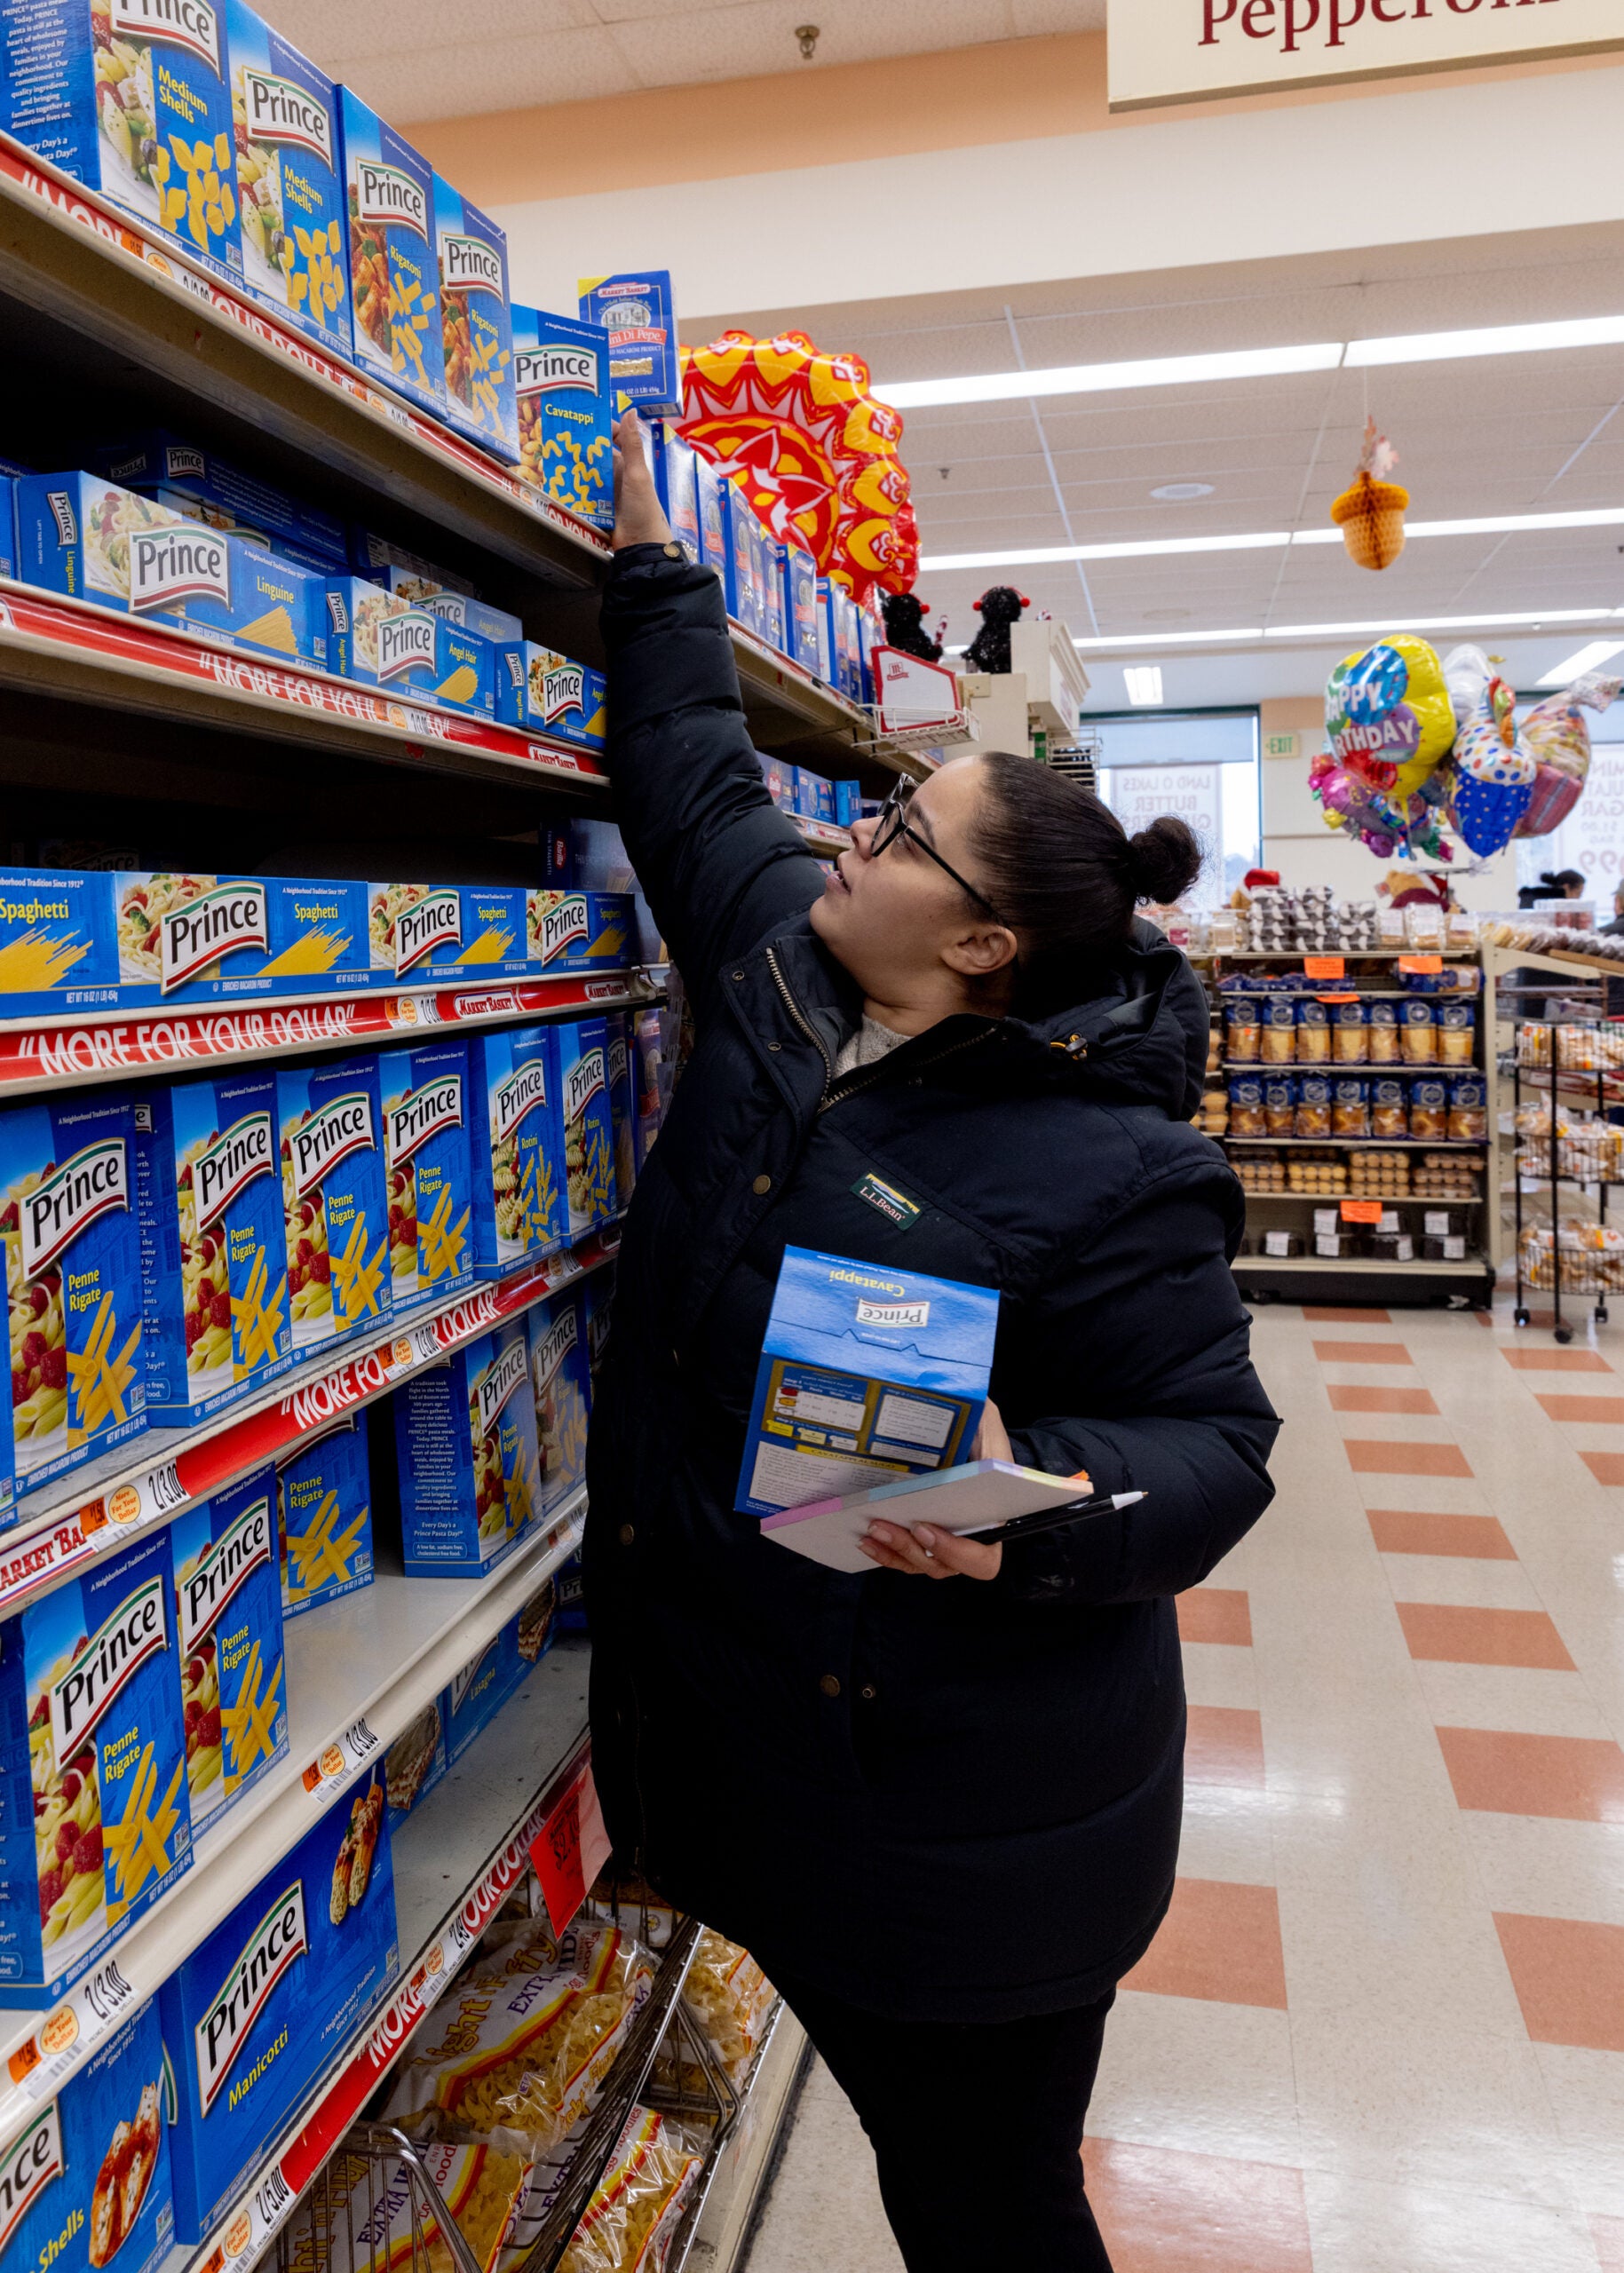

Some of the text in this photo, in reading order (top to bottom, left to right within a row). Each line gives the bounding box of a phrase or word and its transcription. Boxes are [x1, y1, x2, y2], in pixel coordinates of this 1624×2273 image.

[158, 65, 209, 116] Medium
[159, 85, 194, 124] Shells
[252, 81, 325, 142] Prince
[284, 164, 323, 207] Medium
[285, 184, 313, 215] Shells
[364, 169, 422, 219] Prince
[390, 245, 422, 280] Rigatoni
[448, 242, 499, 283] Prince
[471, 308, 499, 339] Rigatoni
[623, 331, 635, 343] Di
[638, 329, 663, 343] Pepe.
[516, 352, 590, 384] Prince
[545, 404, 594, 424] Cavatappi
[170, 449, 202, 469] Prince
[54, 495, 73, 540] Prince
[65, 550, 75, 594] Linguine
[139, 533, 221, 586] Prince
[257, 575, 294, 604] Linguine
[331, 595, 345, 630] Prince
[479, 620, 495, 634] Angel
[494, 624, 506, 637] Hair
[383, 620, 431, 661] Prince
[448, 643, 477, 664] Angel Hair
[510, 655, 521, 684] Prince
[284, 673, 324, 711] FOR
[546, 672, 580, 708] Prince
[1327, 681, 1382, 721] APPY
[1269, 736, 1293, 755] EXIT
[1334, 719, 1414, 757] RTHDAY
[0, 898, 69, 924] Spaghetti
[295, 903, 338, 923] Spaghetti
[400, 903, 456, 954] Prince
[478, 906, 507, 923] Spaghetti
[545, 905, 584, 947] Prince
[170, 899, 257, 965] Prince
[459, 996, 514, 1015] MARKET BASKET
[136, 1021, 194, 1065] FOR
[195, 1010, 271, 1057] YOUR
[501, 1071, 542, 1125] Prince
[571, 1057, 602, 1106] Prince
[394, 1088, 456, 1147] Prince
[587, 1117, 600, 1131] Rotini
[297, 1107, 364, 1176] Prince
[521, 1133, 538, 1151] Rotini
[201, 1128, 266, 1206] Prince
[419, 1165, 441, 1181] Penne
[32, 1157, 118, 1248] Prince
[329, 1193, 353, 1209] Penne
[419, 1179, 443, 1195] Rigate
[860, 1186, 904, 1222] L.L.Bean
[230, 1225, 255, 1243] Penne
[329, 1208, 355, 1226] Rigate
[232, 1243, 257, 1263] Rigate
[68, 1269, 99, 1291] Penne
[829, 1270, 905, 1298] Cavatappi
[69, 1288, 101, 1312] Rigate
[863, 1307, 923, 1324] Prince
[540, 1314, 575, 1377] Prince
[354, 1351, 386, 1397] FO
[483, 1348, 524, 1417] Prince
[502, 1424, 518, 1440] Penne
[503, 1437, 519, 1453] Rigate
[115, 1491, 130, 1501] More
[147, 1463, 187, 1510] 2/3.00
[289, 1475, 322, 1494] Penne
[290, 1488, 324, 1509] Rigate
[112, 1497, 137, 1515] For Your
[118, 1507, 137, 1521] Dollar
[0, 1539, 55, 1591] ARKET
[96, 1565, 128, 1588] Neighborhood
[127, 1553, 147, 1572] Tradition
[146, 1547, 156, 1559] Since
[189, 1517, 264, 1628] Prince
[222, 1624, 250, 1655] Penne
[62, 1599, 156, 1735] Prince
[223, 1642, 250, 1673] Rigate
[103, 1726, 139, 1763] Penne
[105, 1746, 141, 1785] Rigate
[84, 1959, 132, 2020] 2/3.00
[207, 1906, 297, 2073] Prince
[324, 1987, 357, 2036] Neighborhood
[356, 1965, 376, 1994] Tradition
[44, 2016, 73, 2047] For Your
[48, 2011, 65, 2030] More
[87, 1997, 154, 2078] A Neighborhood Tradition
[335, 2015, 349, 2034] Since
[51, 2028, 75, 2051] Dollar
[107, 2050, 123, 2069] Since
[228, 2024, 289, 2112] Manicotti
[256, 2164, 289, 2225] 2/5.00
[38, 2207, 85, 2273] Shells
[226, 2237, 236, 2250] For
[233, 2231, 249, 2253] Dollar
